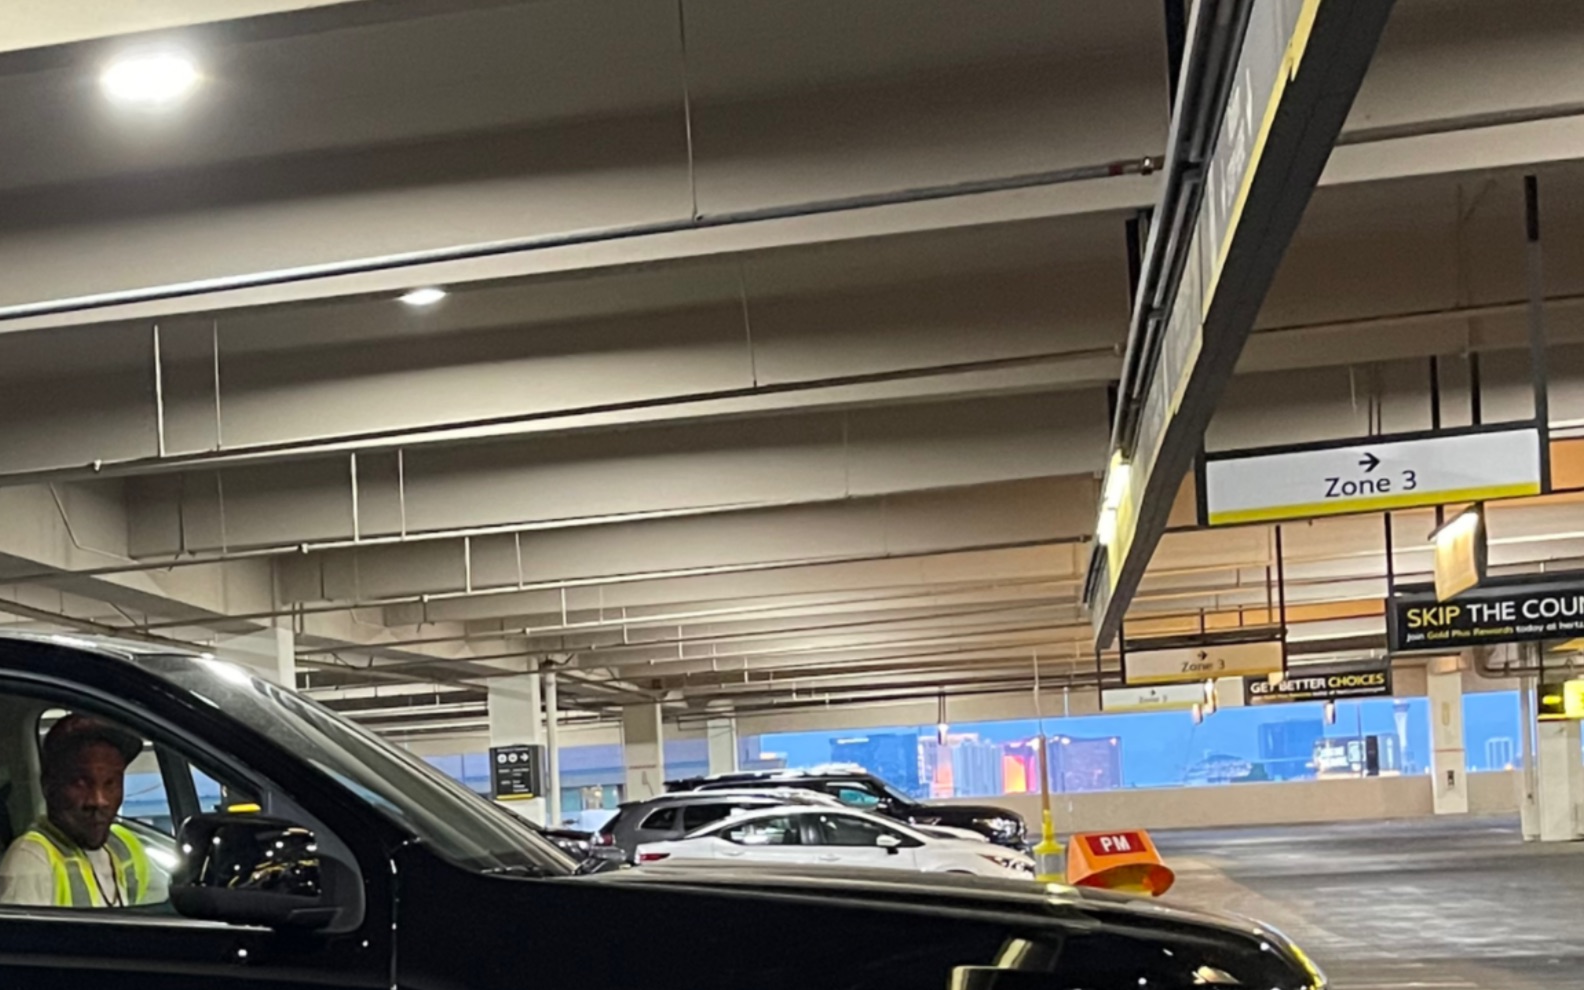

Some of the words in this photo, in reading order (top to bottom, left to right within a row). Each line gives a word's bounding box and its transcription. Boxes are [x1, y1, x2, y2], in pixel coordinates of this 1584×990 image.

[1324, 476, 1391, 498] Zone
[1402, 469, 1417, 491] 3
[1406, 605, 1461, 629] SKIP
[1466, 601, 1516, 623] THE
[1427, 629, 1450, 640] Gold
[1473, 625, 1514, 636] Rewards
[1516, 624, 1544, 633] today
[1181, 661, 1214, 673] Zone
[1278, 677, 1326, 692] BETTER
[1328, 672, 1385, 688] CHOICES
[1099, 834, 1132, 852] PM
